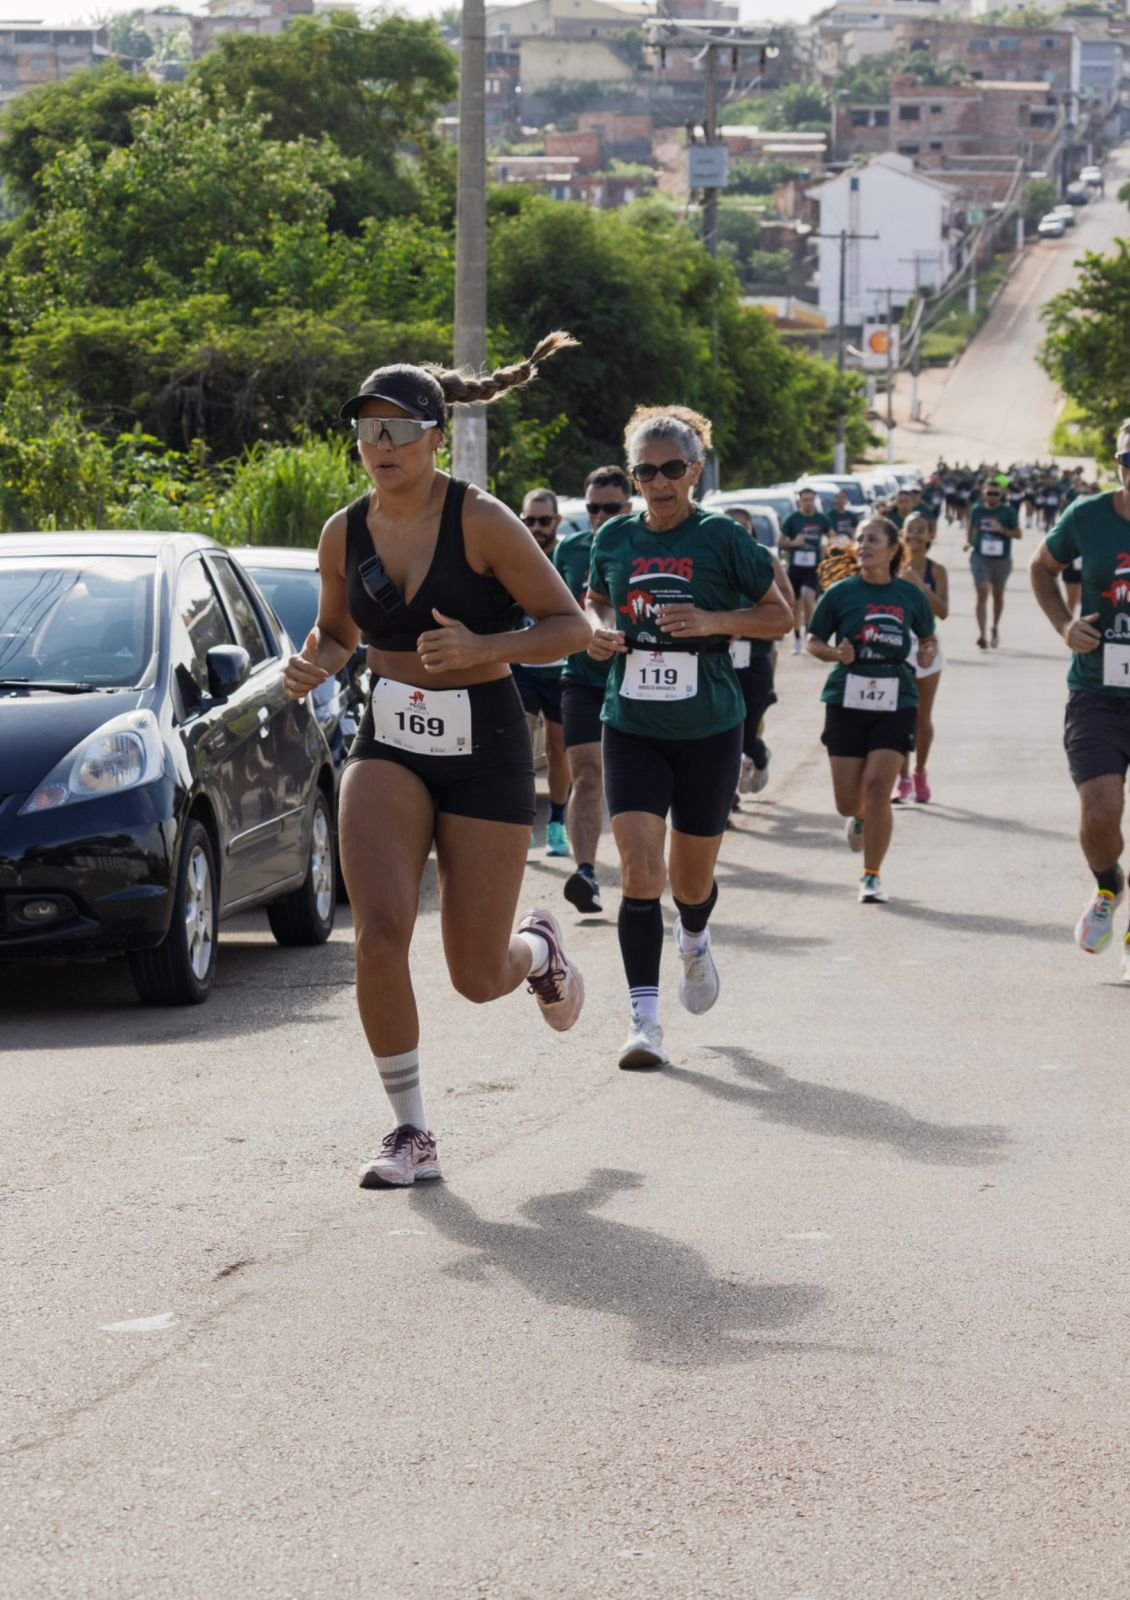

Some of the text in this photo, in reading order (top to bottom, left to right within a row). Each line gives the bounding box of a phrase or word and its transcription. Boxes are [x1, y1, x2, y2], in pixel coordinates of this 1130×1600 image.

[631, 556, 694, 581] 2026
[1115, 551, 1130, 569] 2
[639, 668, 678, 685] 119
[858, 690, 885, 701] 147
[394, 711, 445, 737] 169
